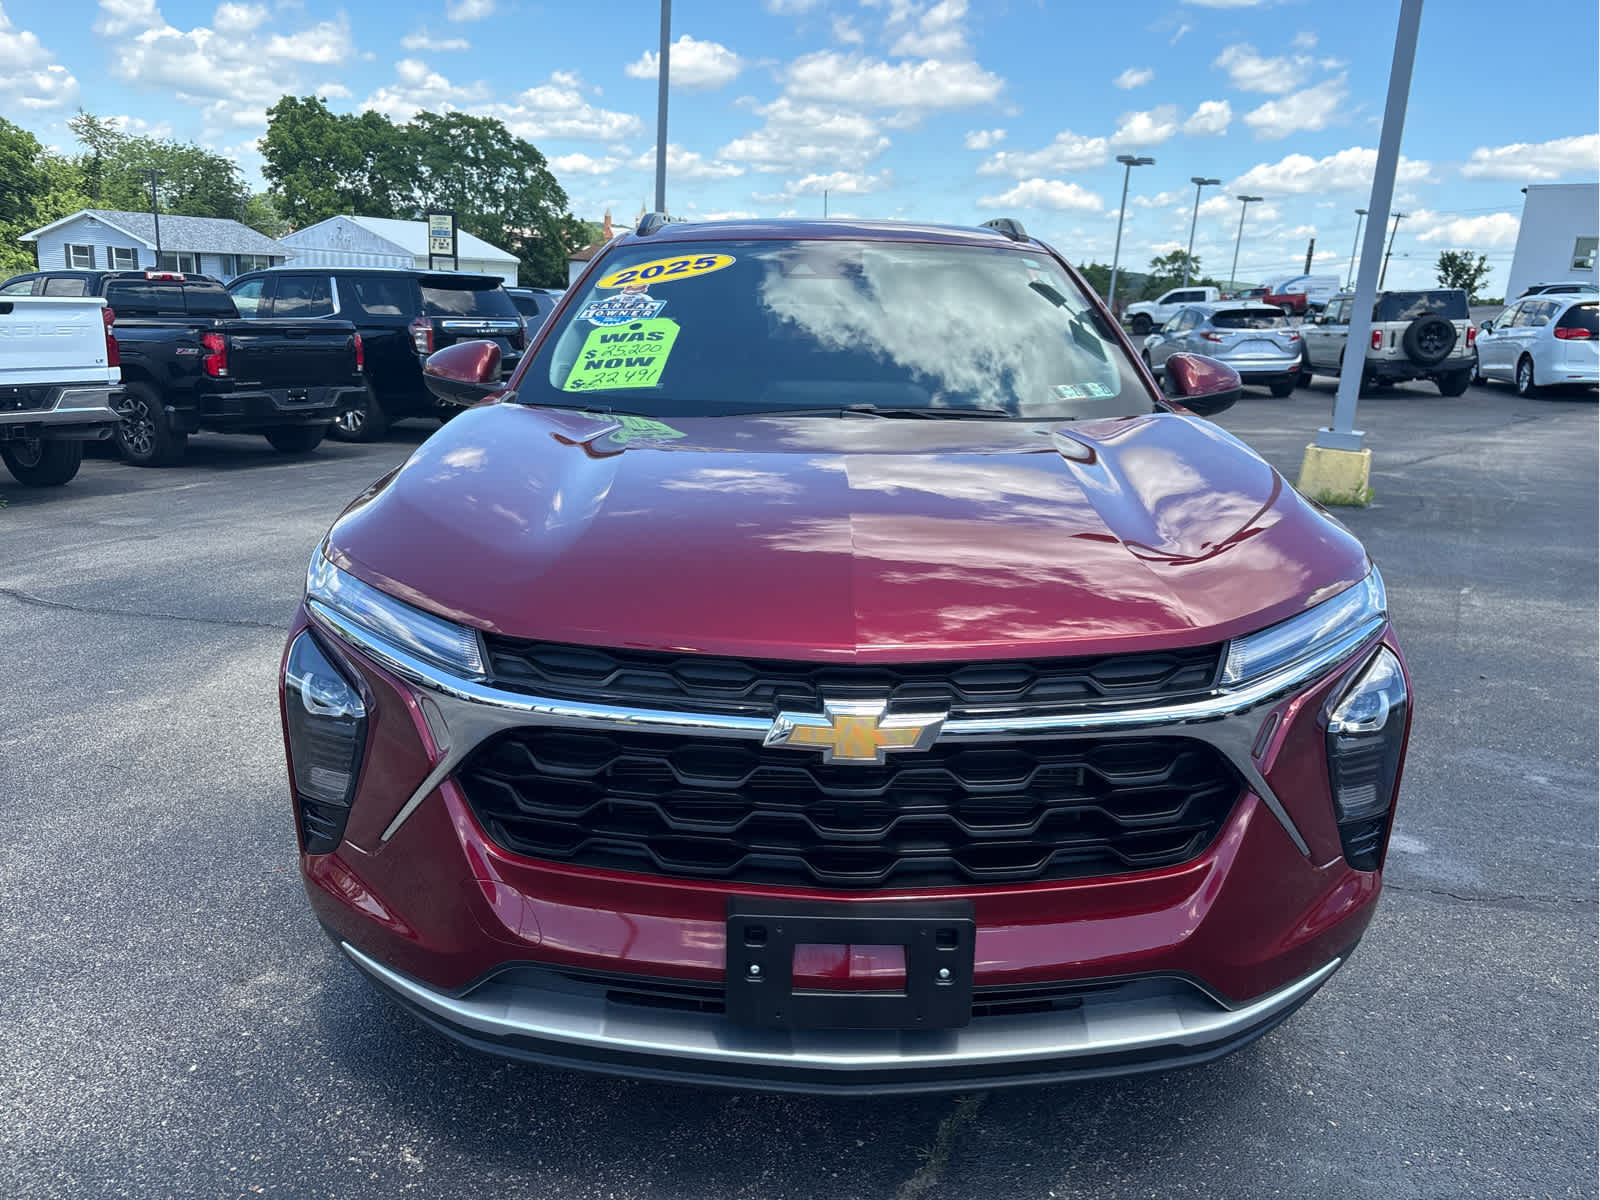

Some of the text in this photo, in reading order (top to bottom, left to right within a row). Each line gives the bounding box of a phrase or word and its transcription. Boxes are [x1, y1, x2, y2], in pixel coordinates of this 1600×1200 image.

[615, 256, 718, 287] 2025
[589, 302, 658, 310] CARFAX
[600, 332, 665, 343] WAS
[584, 357, 656, 370] NOW
